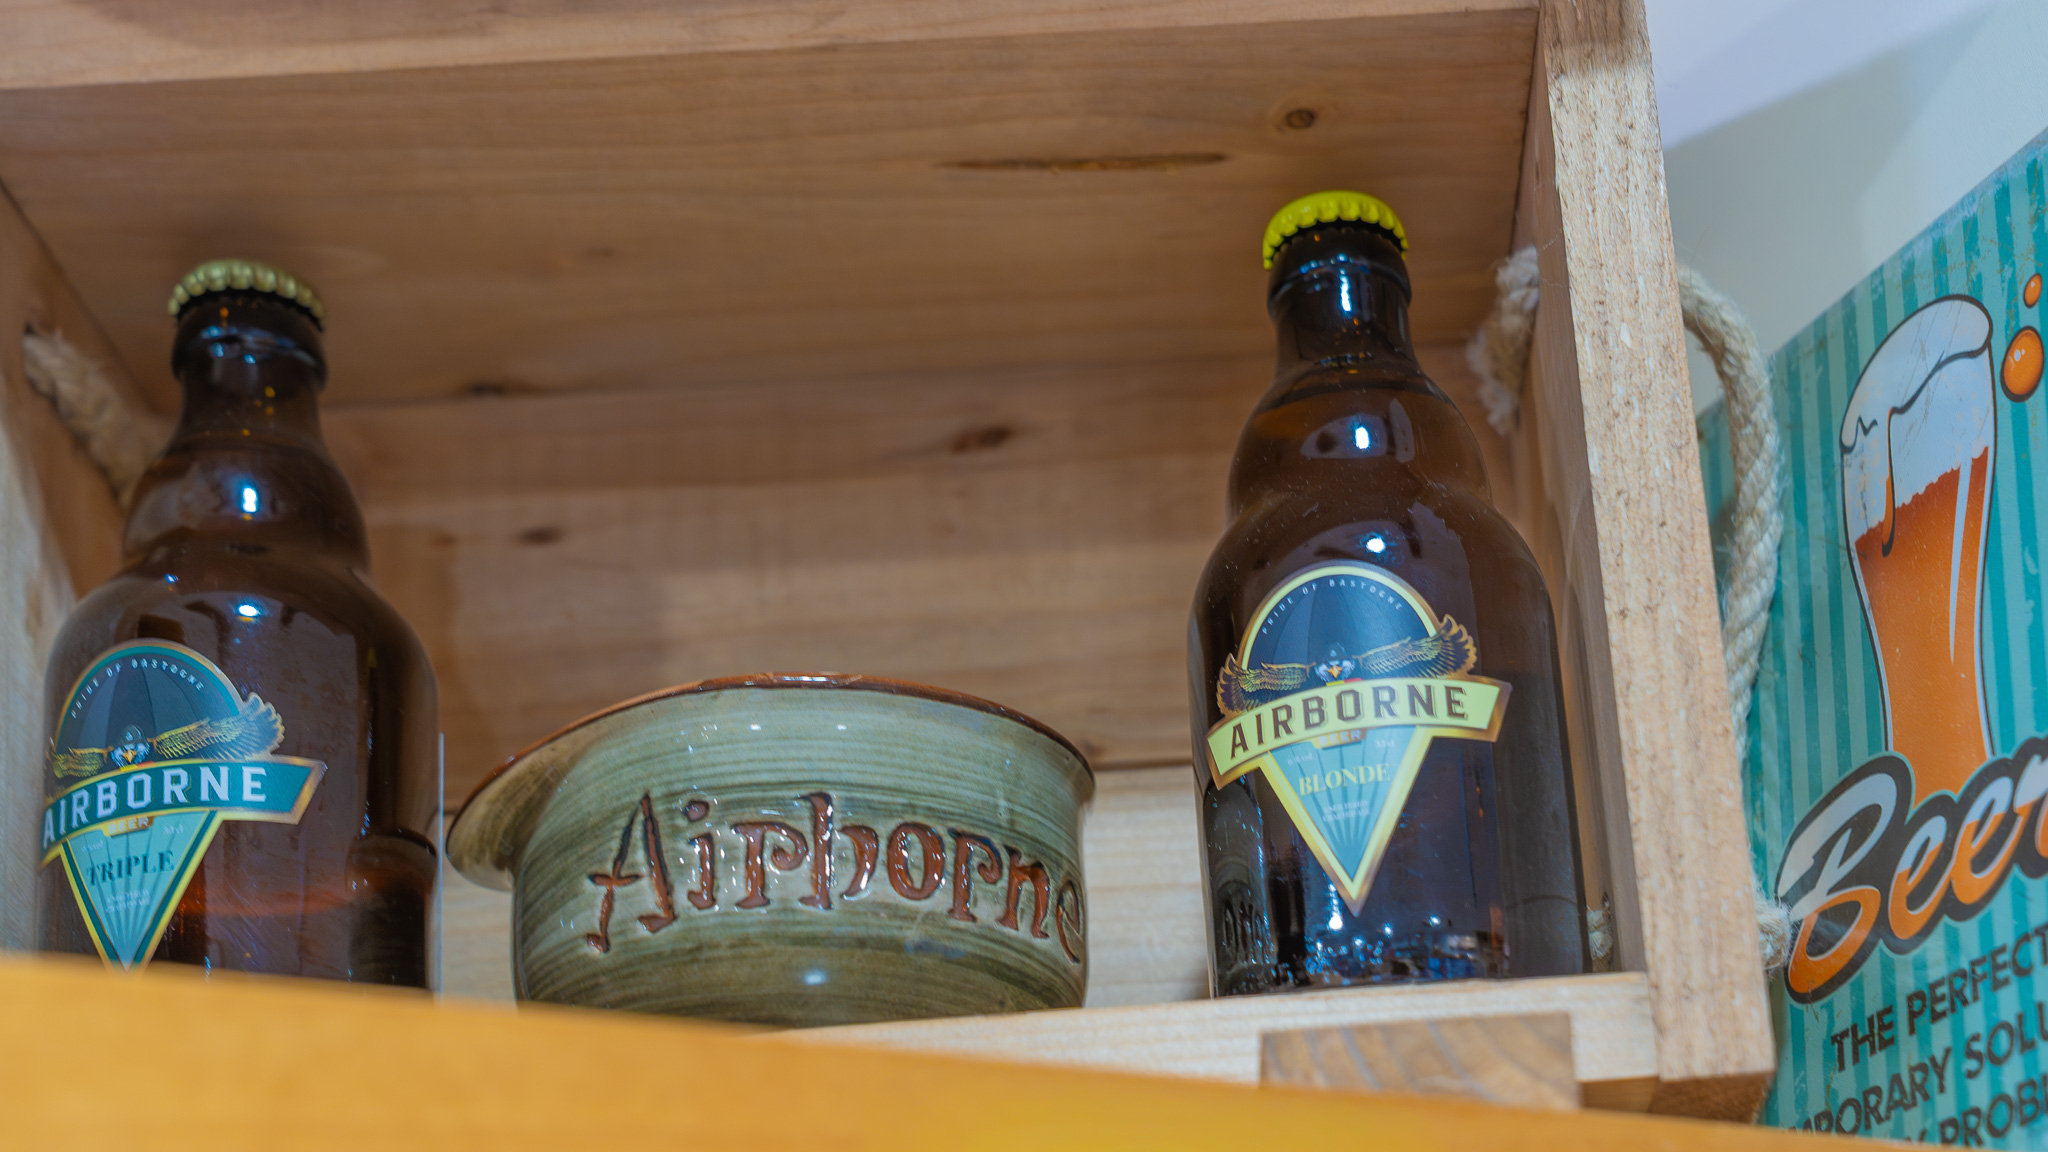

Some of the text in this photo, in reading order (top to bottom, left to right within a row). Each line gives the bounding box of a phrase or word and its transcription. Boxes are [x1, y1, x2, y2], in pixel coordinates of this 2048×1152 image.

[1262, 578, 1403, 635] PRIDE OF BASTOGNE
[131, 658, 205, 692] BASTOGNE
[1230, 684, 1469, 760] AIRBORNE
[1318, 729, 1362, 747] BEER
[1299, 763, 1392, 797] BLONDE
[42, 765, 267, 850] AIRBORNE
[108, 816, 149, 835] BEER
[86, 850, 175, 886] TRIPLE
[1831, 922, 2048, 1073] THE PERFECT
